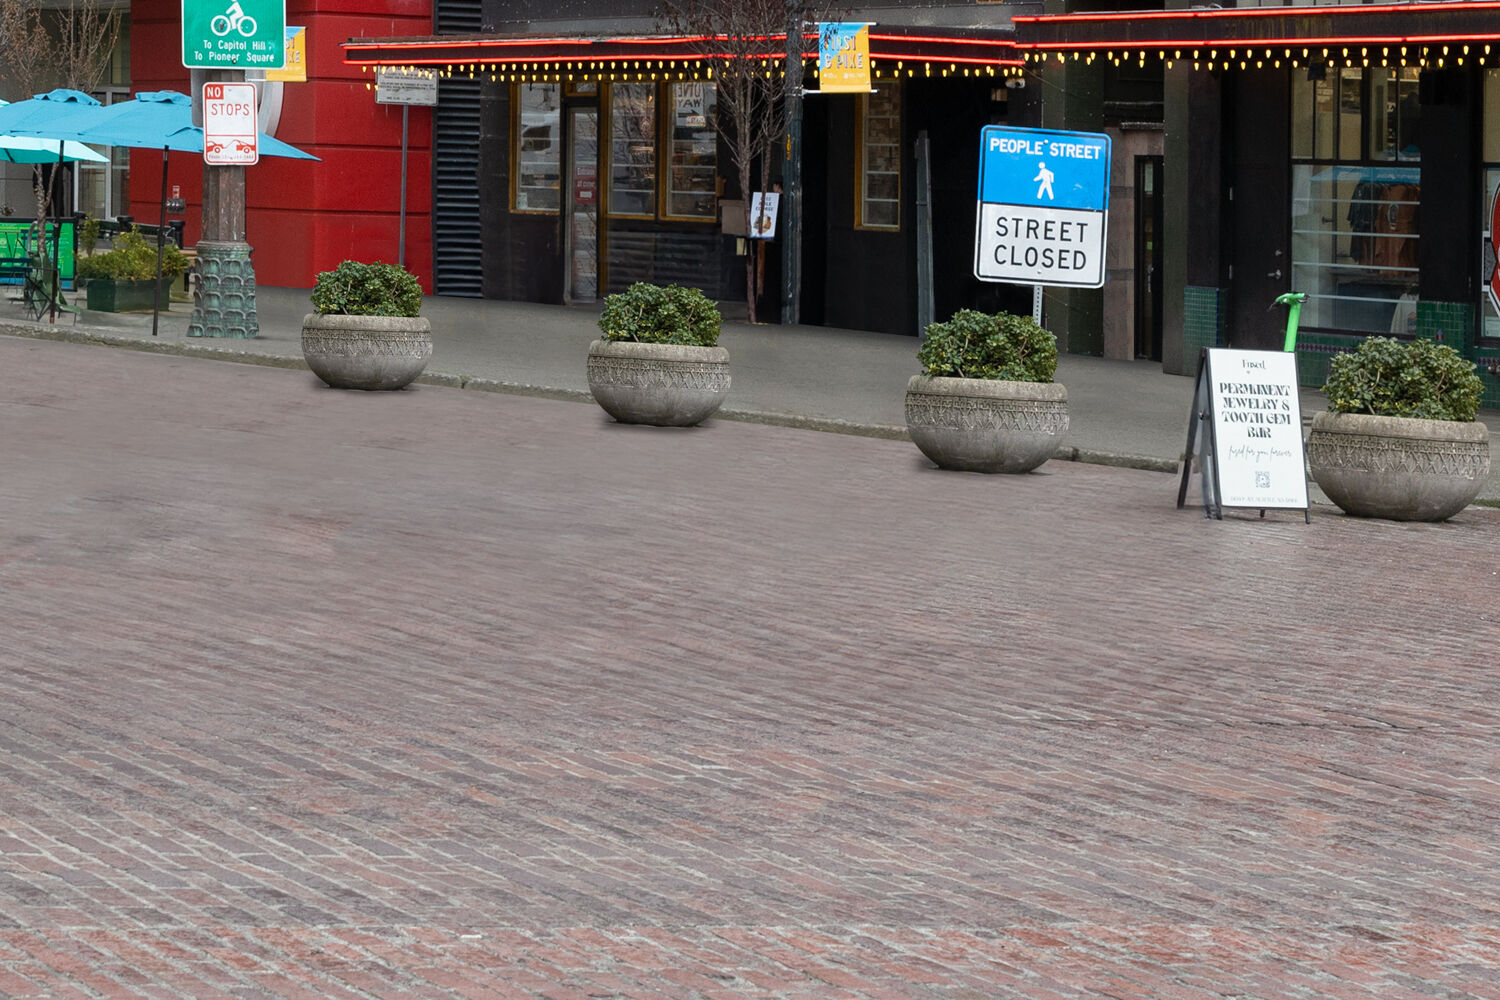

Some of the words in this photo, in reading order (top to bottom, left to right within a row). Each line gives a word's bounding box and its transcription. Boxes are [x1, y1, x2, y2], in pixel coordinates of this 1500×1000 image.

[203, 40, 211, 49] To
[218, 40, 246, 51] Capitol
[252, 41, 266, 50] Hill
[195, 51, 202, 60] To
[209, 52, 239, 61] Pioneer
[246, 52, 274, 63] Square
[837, 53, 863, 69] PIKE
[207, 86, 221, 98] NO
[211, 103, 250, 116] STOPS
[990, 138, 1043, 155] PEOPLE
[1050, 142, 1101, 160] STREET
[996, 216, 1088, 243] STREET
[994, 244, 1087, 270] CLOSED
[1220, 382, 1290, 397] PERMANENT
[1223, 397, 1278, 411] JEWELRY
[1282, 399, 1290, 412] &
[1222, 411, 1264, 424] TOOTH
[1266, 413, 1291, 426] GEM
[1247, 427, 1272, 439] BAR
